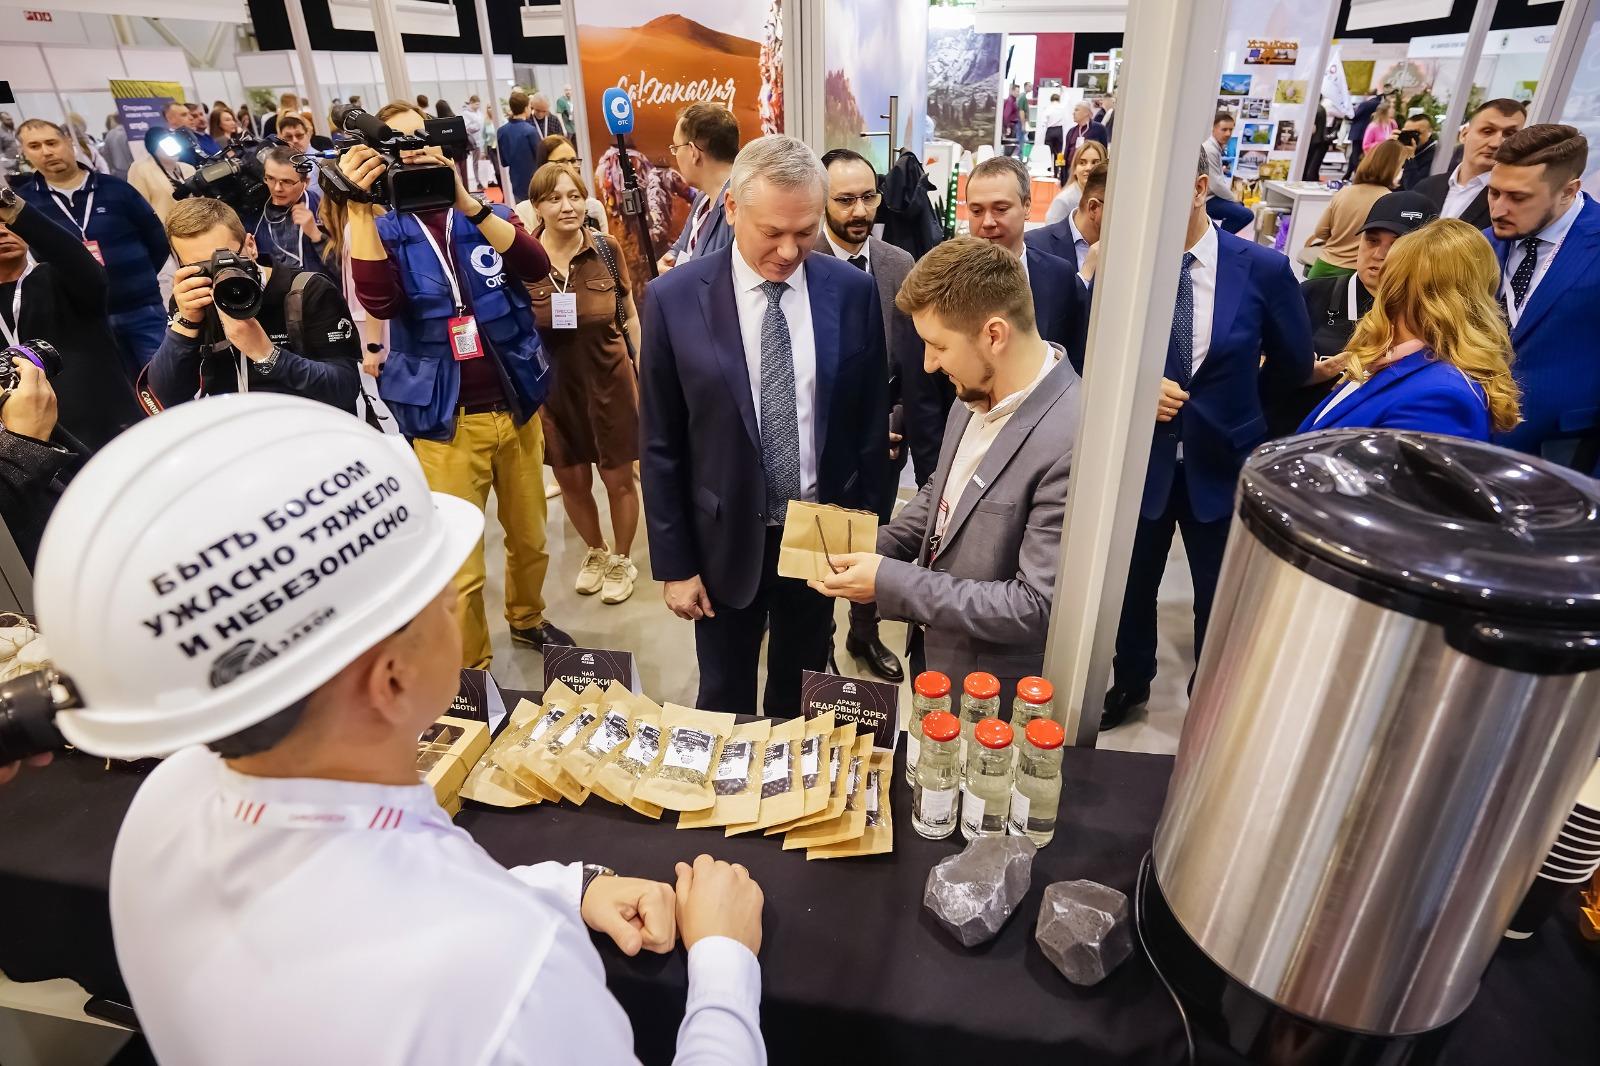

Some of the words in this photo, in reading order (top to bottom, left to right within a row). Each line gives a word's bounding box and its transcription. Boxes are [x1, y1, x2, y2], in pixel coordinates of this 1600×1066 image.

[140, 390, 160, 416] Canon
[150, 529, 258, 597] БЫТЬ
[261, 460, 371, 533] БОССОМ
[143, 545, 296, 638] УЖАСНО
[299, 475, 401, 544] ТЯЖЕЛО
[178, 633, 211, 658] И
[213, 505, 410, 639] НЕБЕЗОПАСНО
[450, 703, 477, 712] АБОТЫ
[809, 700, 861, 716] КЕДРОВЫЙ
[863, 709, 888, 721] ОРЕХ
[831, 711, 879, 727] ОКОЛАДЕ
